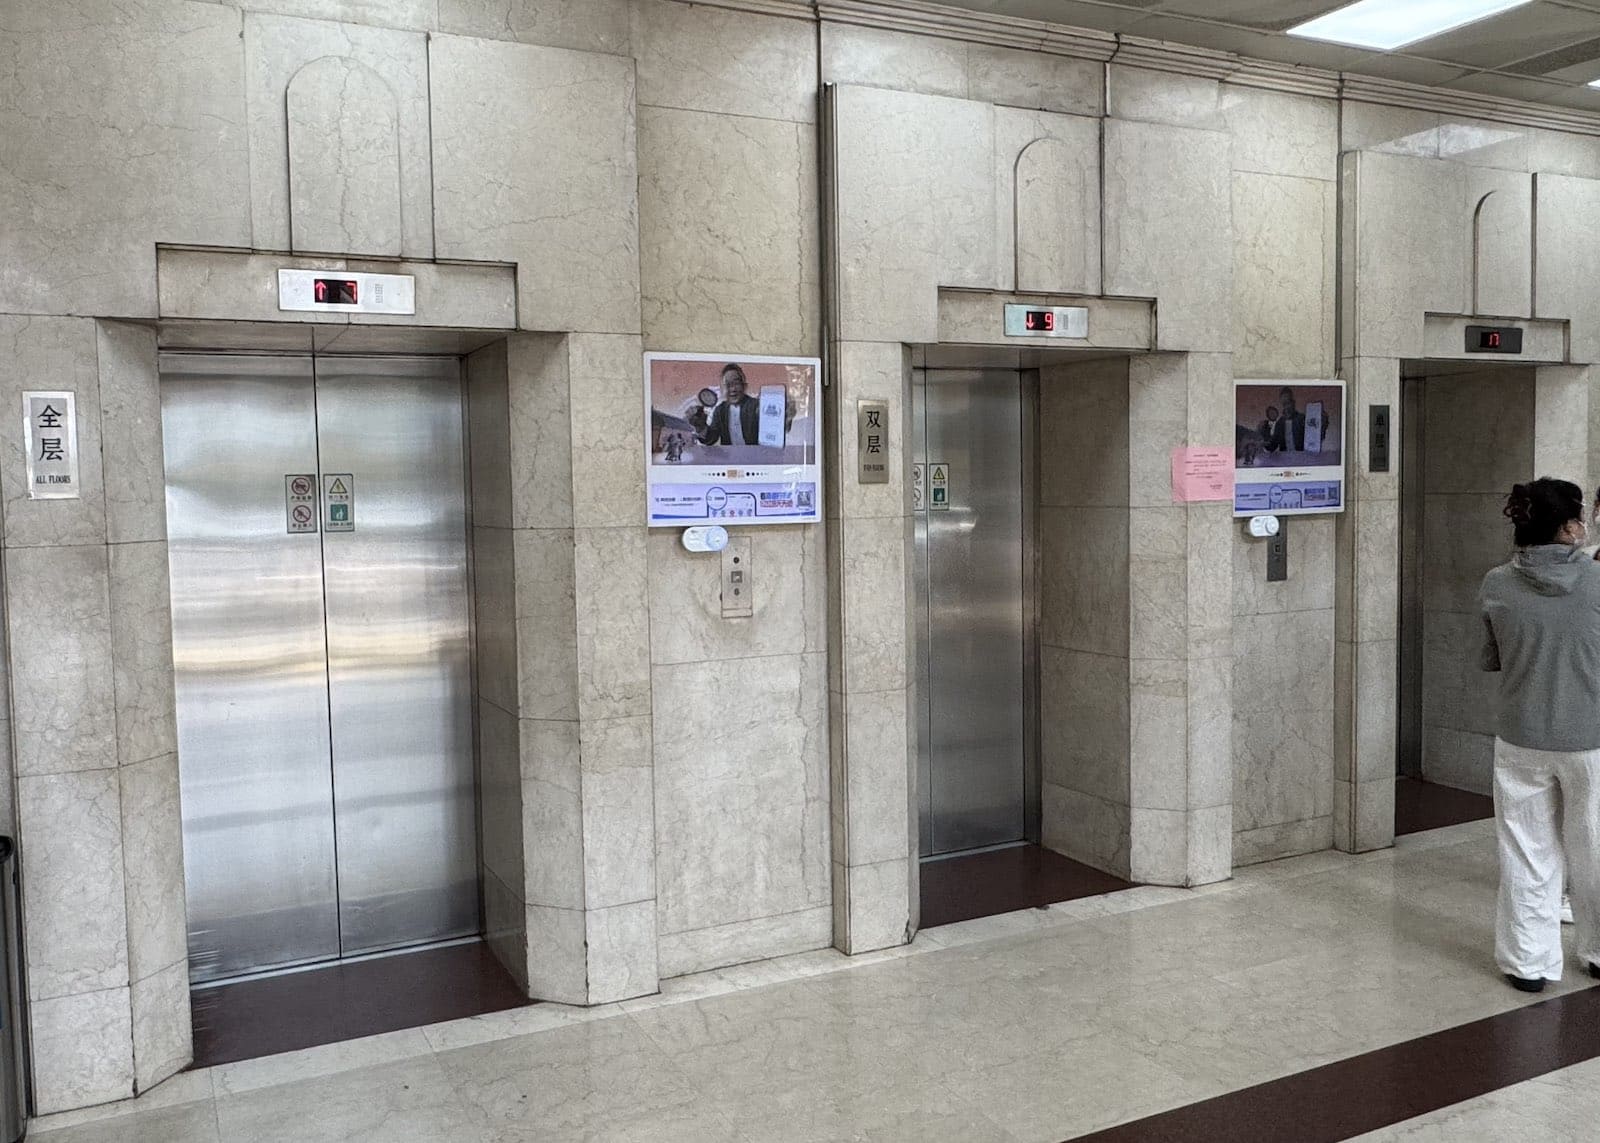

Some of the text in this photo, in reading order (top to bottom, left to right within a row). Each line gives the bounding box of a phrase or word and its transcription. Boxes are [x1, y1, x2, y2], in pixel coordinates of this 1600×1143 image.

[346, 281, 358, 301] 7
[1043, 312, 1054, 330] 9
[37, 404, 64, 461] 全层
[865, 410, 881, 454] 双层
[35, 474, 72, 484] ALL FLOORS
